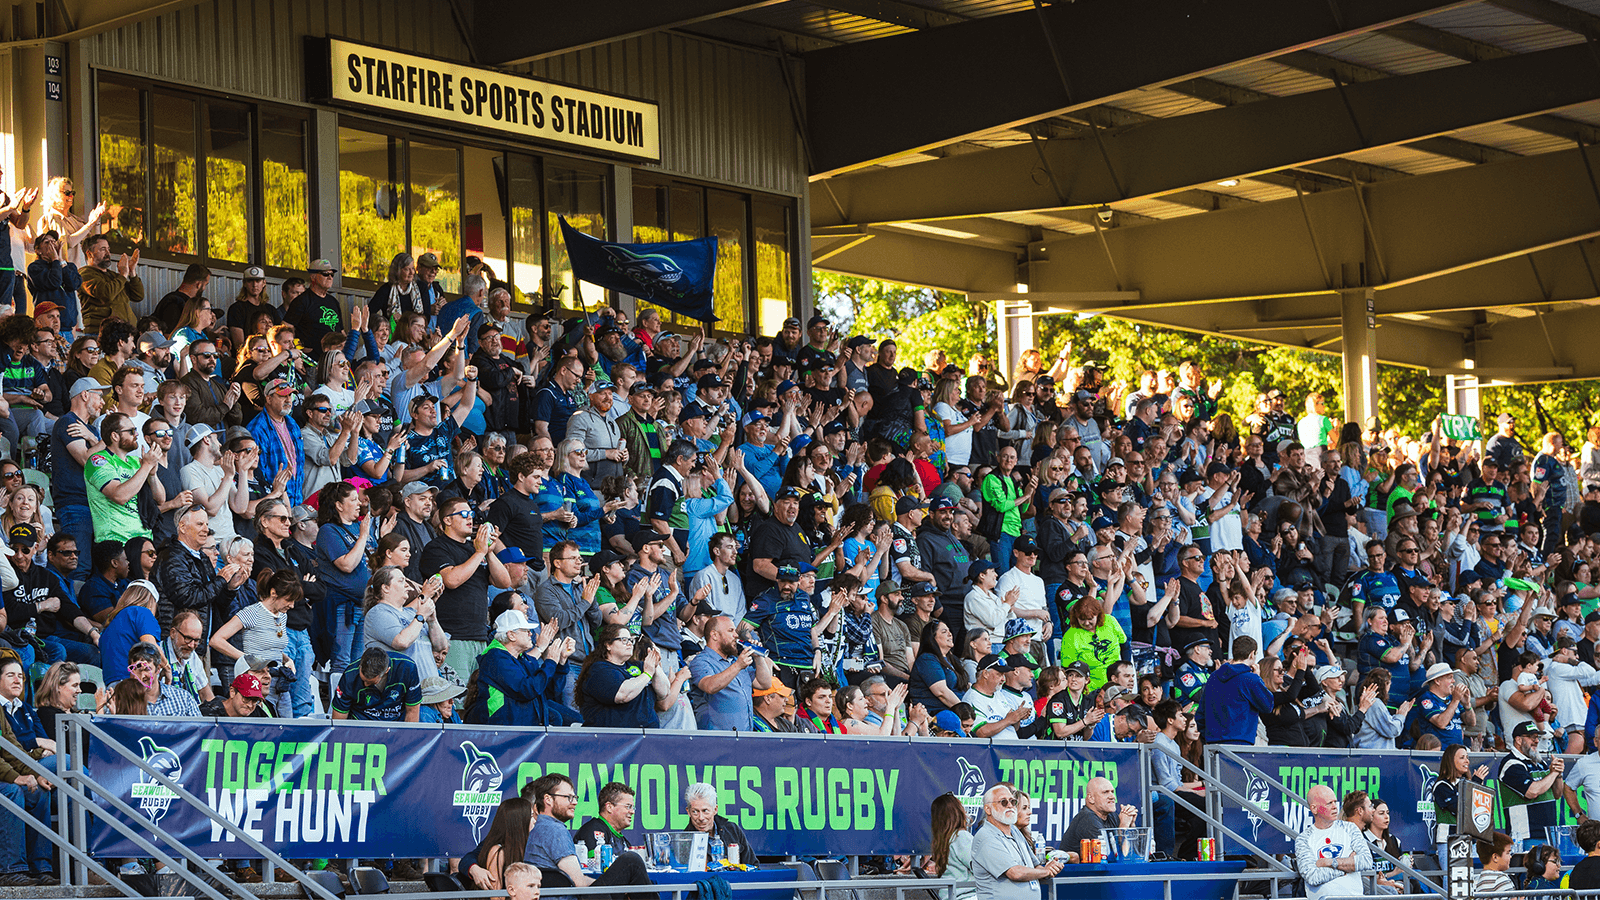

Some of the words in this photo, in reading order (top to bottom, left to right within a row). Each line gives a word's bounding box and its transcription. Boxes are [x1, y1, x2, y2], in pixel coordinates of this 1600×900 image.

[48, 57, 59, 69] 103
[48, 82, 60, 94] 104
[348, 53, 455, 111] STARFIRE
[460, 77, 545, 129] SPORTS
[551, 95, 644, 147] STADIUM
[1442, 414, 1476, 438] TRY
[201, 739, 388, 796] TOGETHER
[132, 785, 178, 796] SEAWOLV
[999, 759, 1118, 805] TOGETHR
[141, 797, 170, 807] RUGBY
[454, 793, 501, 803] SEAWOLVES
[517, 761, 900, 831] AWOLES.RUGBY
[1474, 791, 1490, 808] MLR
[207, 788, 269, 843] WE
[274, 788, 376, 843] HUNT
[464, 805, 490, 815] RUGBY
